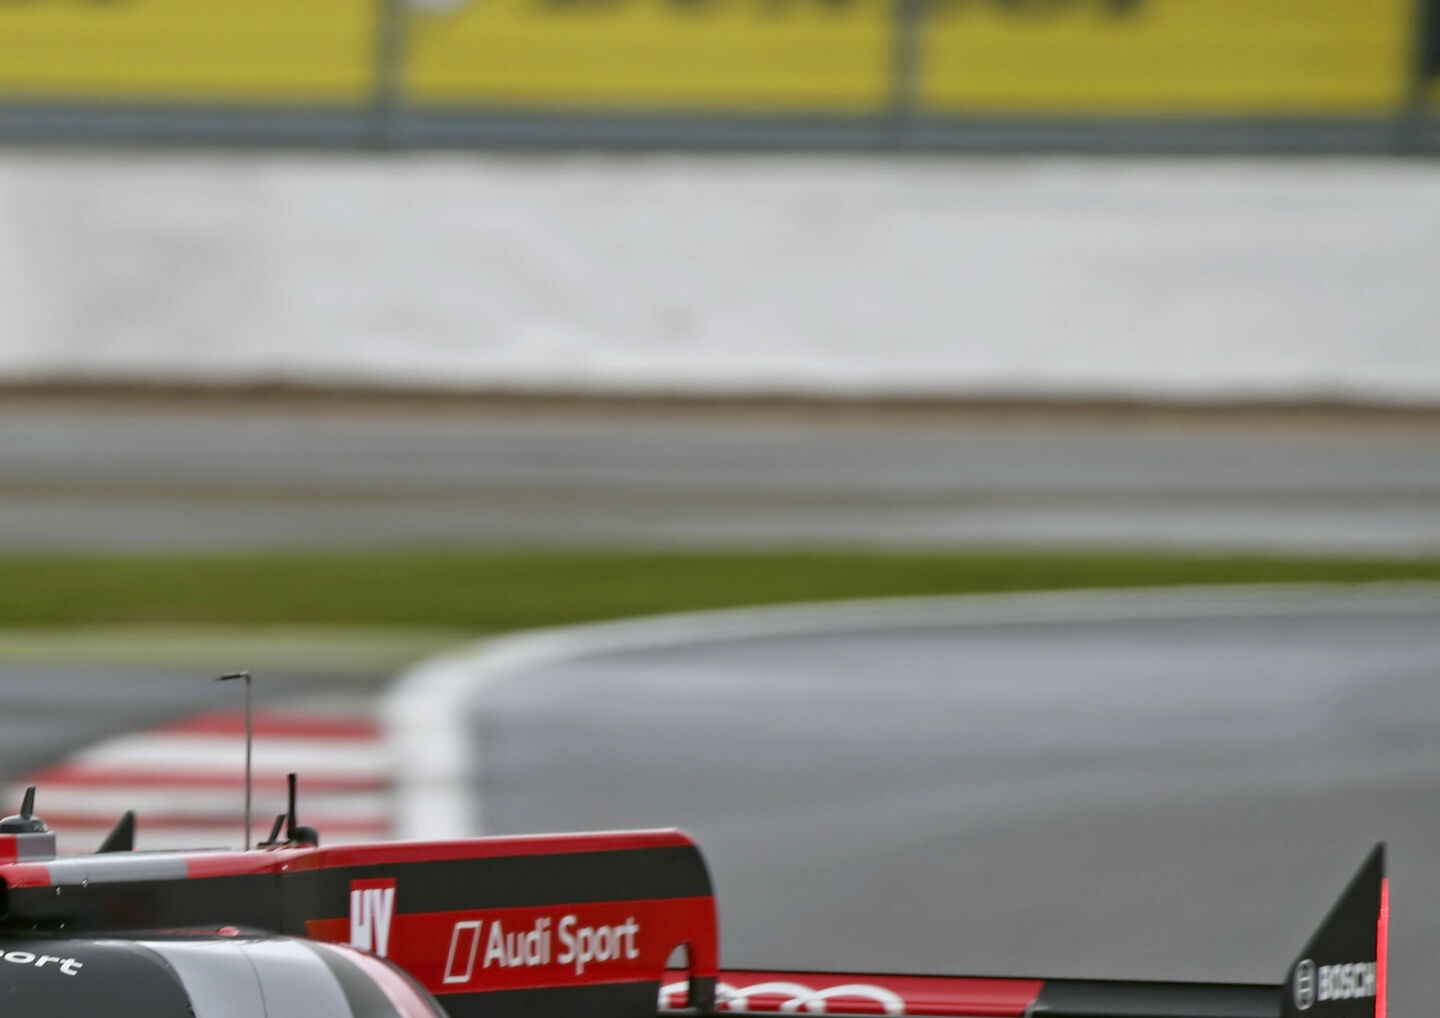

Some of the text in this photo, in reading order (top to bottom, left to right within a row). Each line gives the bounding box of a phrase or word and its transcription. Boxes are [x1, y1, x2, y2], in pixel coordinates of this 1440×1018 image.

[483, 915, 640, 976] Audi Sport
[1317, 961, 1376, 1001] BOSCH
